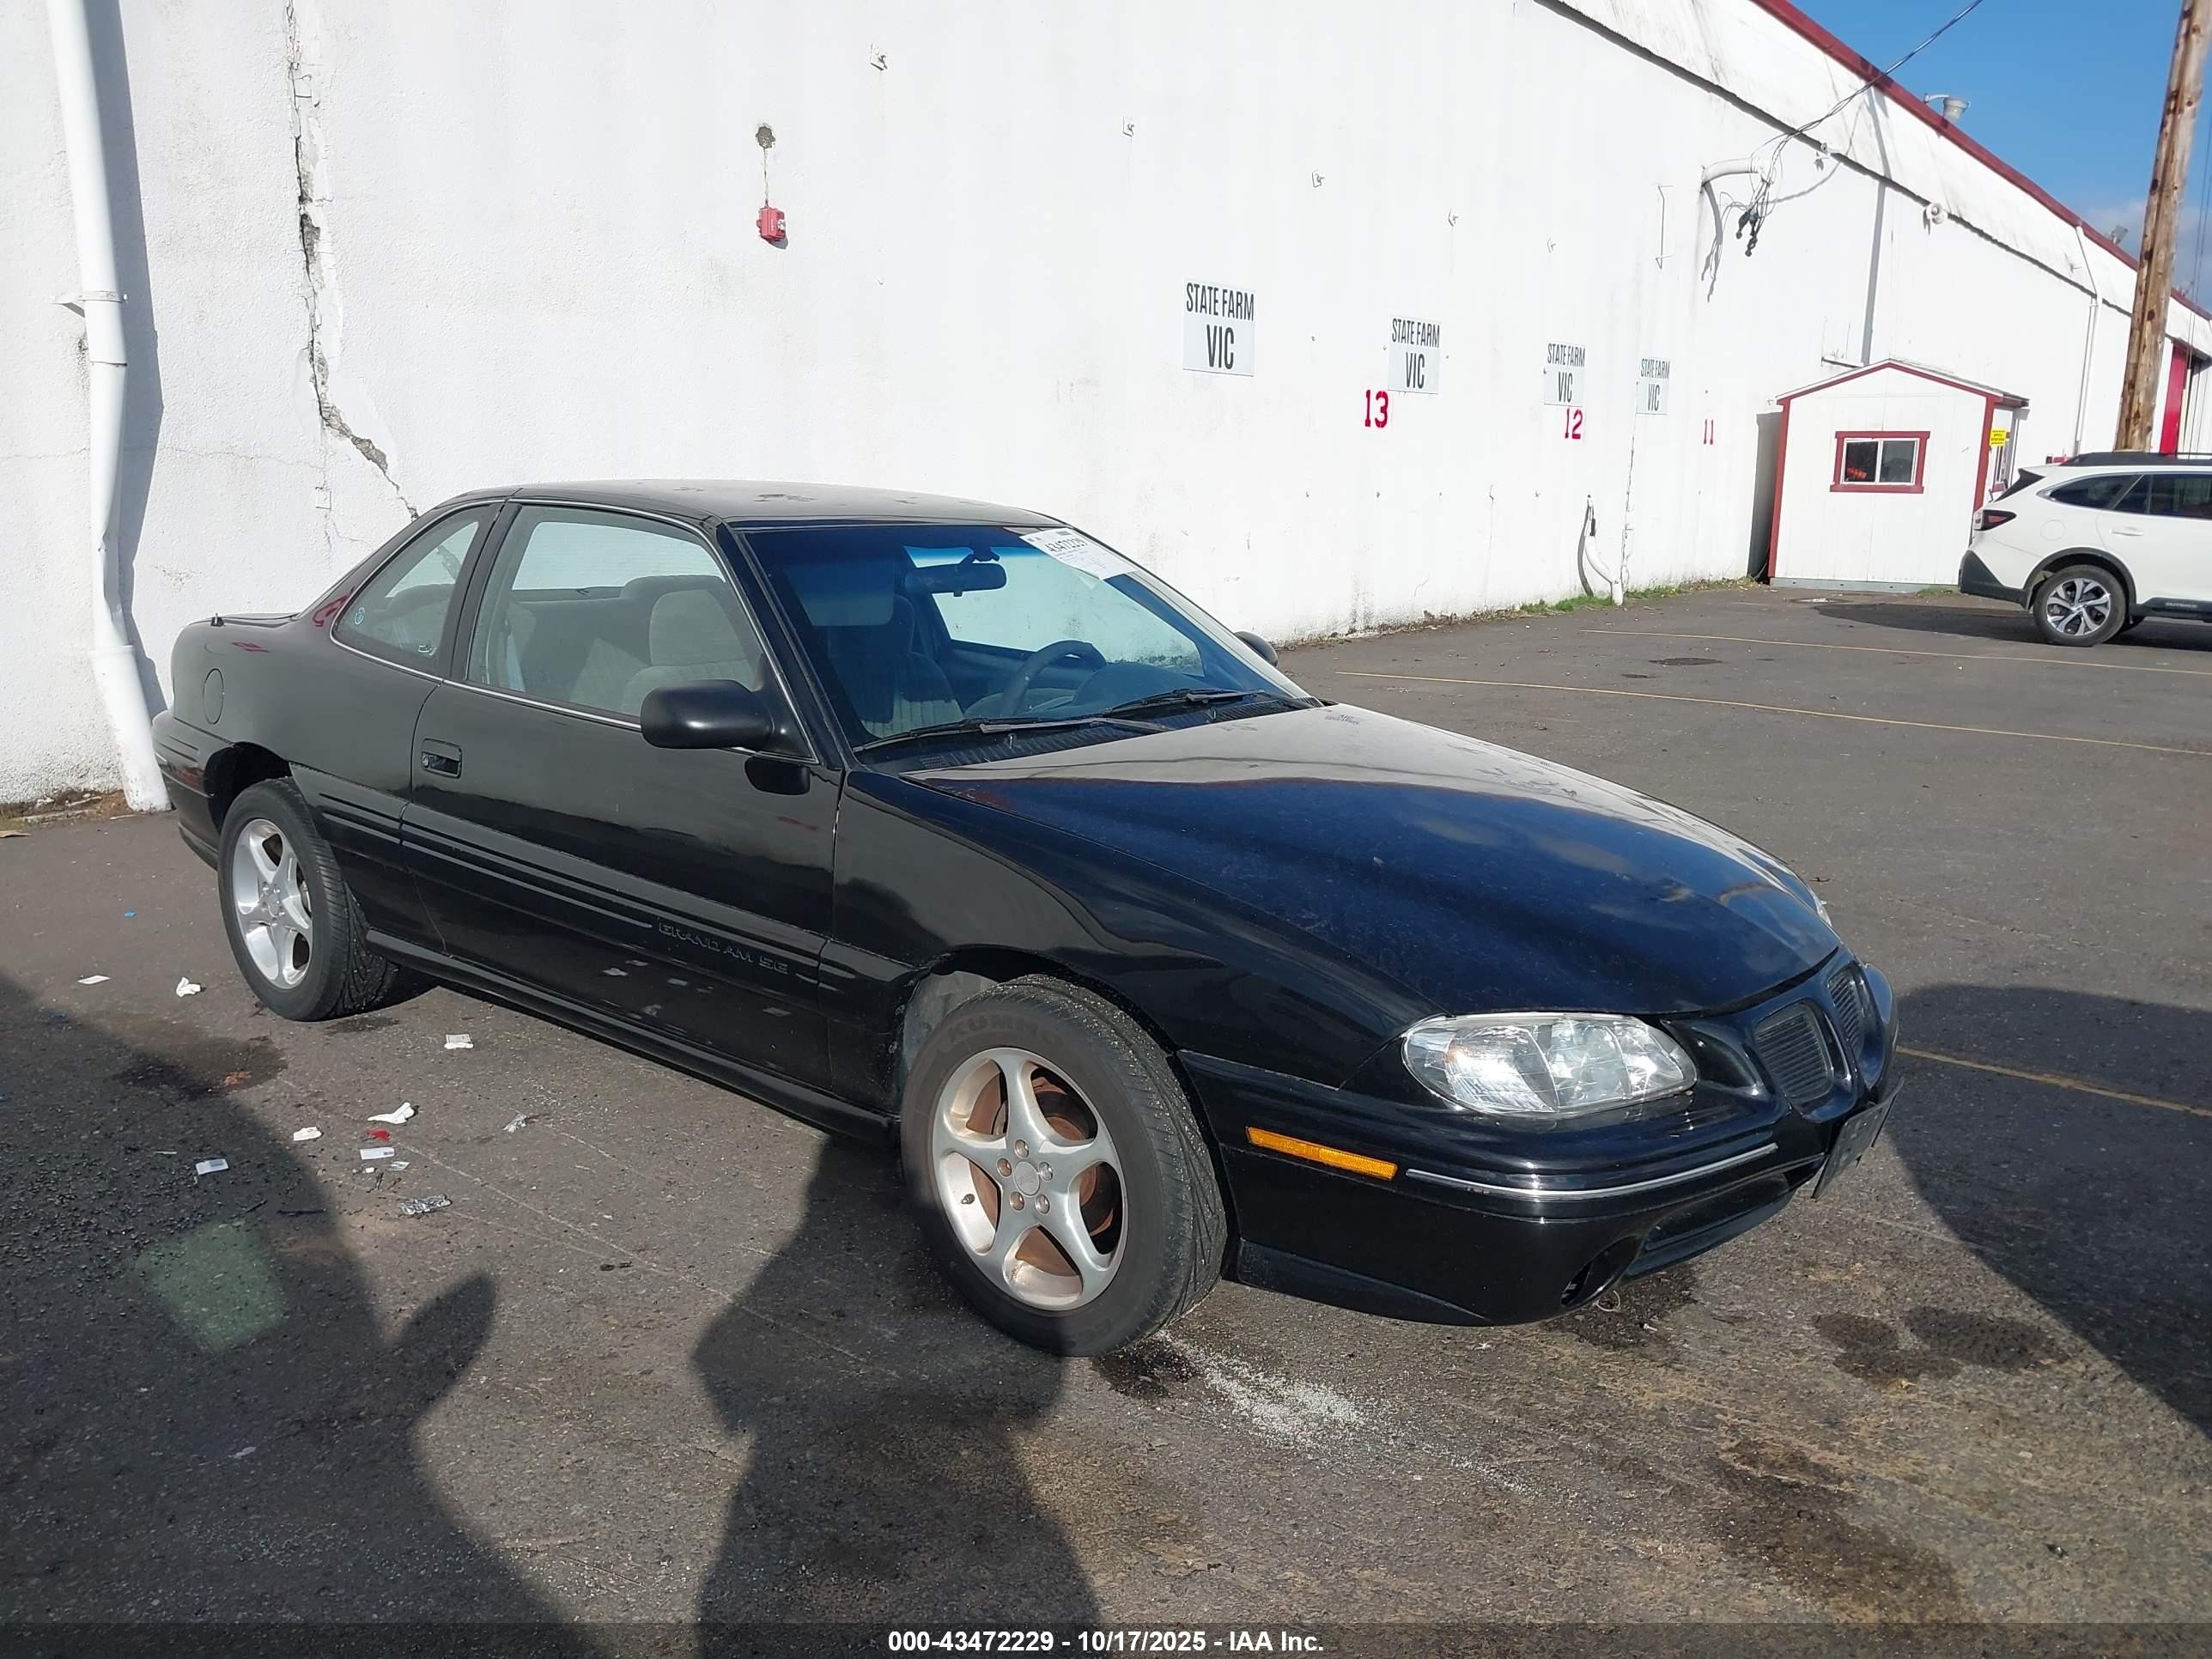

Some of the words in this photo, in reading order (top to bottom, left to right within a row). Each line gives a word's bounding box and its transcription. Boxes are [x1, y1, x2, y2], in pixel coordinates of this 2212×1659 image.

[1187, 282, 1219, 316] STATE
[1222, 289, 1255, 321] FARM
[1206, 324, 1234, 369] VIC
[1392, 318, 1414, 345] STATE
[1417, 322, 1440, 349] FARM
[1406, 352, 1425, 389] VIC
[1547, 343, 1566, 365] STATE
[1567, 346, 1585, 368] FARM
[1640, 358, 1656, 378] STATE
[1656, 361, 1670, 380] FARM
[1558, 371, 1573, 403] VIC
[1648, 383, 1660, 411] VIC
[1364, 389, 1389, 428] 13
[1565, 408, 1583, 440] 12
[1704, 419, 1714, 445] 11
[659, 922, 720, 952] GRAND
